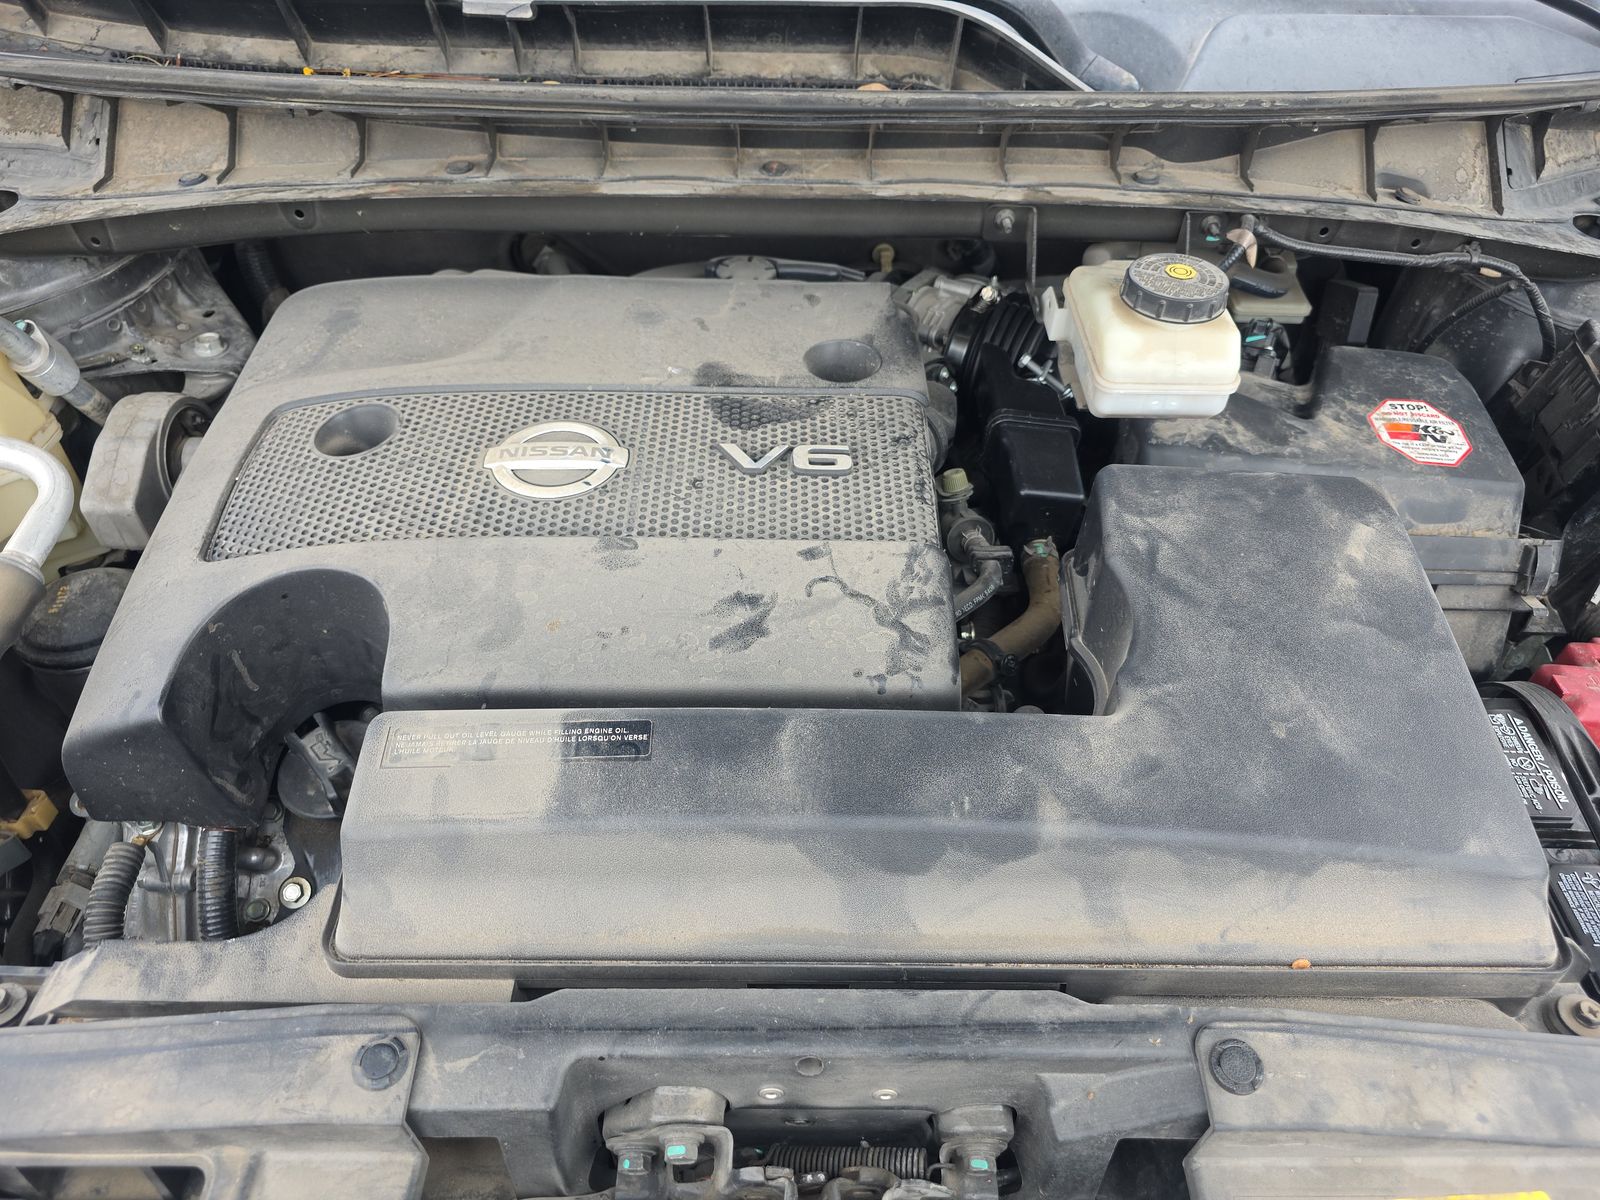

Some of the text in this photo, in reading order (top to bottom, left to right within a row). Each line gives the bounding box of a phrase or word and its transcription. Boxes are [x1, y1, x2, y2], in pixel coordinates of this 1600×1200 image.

[1389, 403, 1429, 412] STOP!
[499, 445, 612, 458] NISSAN
[714, 443, 853, 475] V6
[476, 730, 498, 738] LEVEL
[578, 734, 622, 742] LORSQU'ON
[1518, 726, 1545, 761] DANGER
[1542, 768, 1569, 803] POISON
